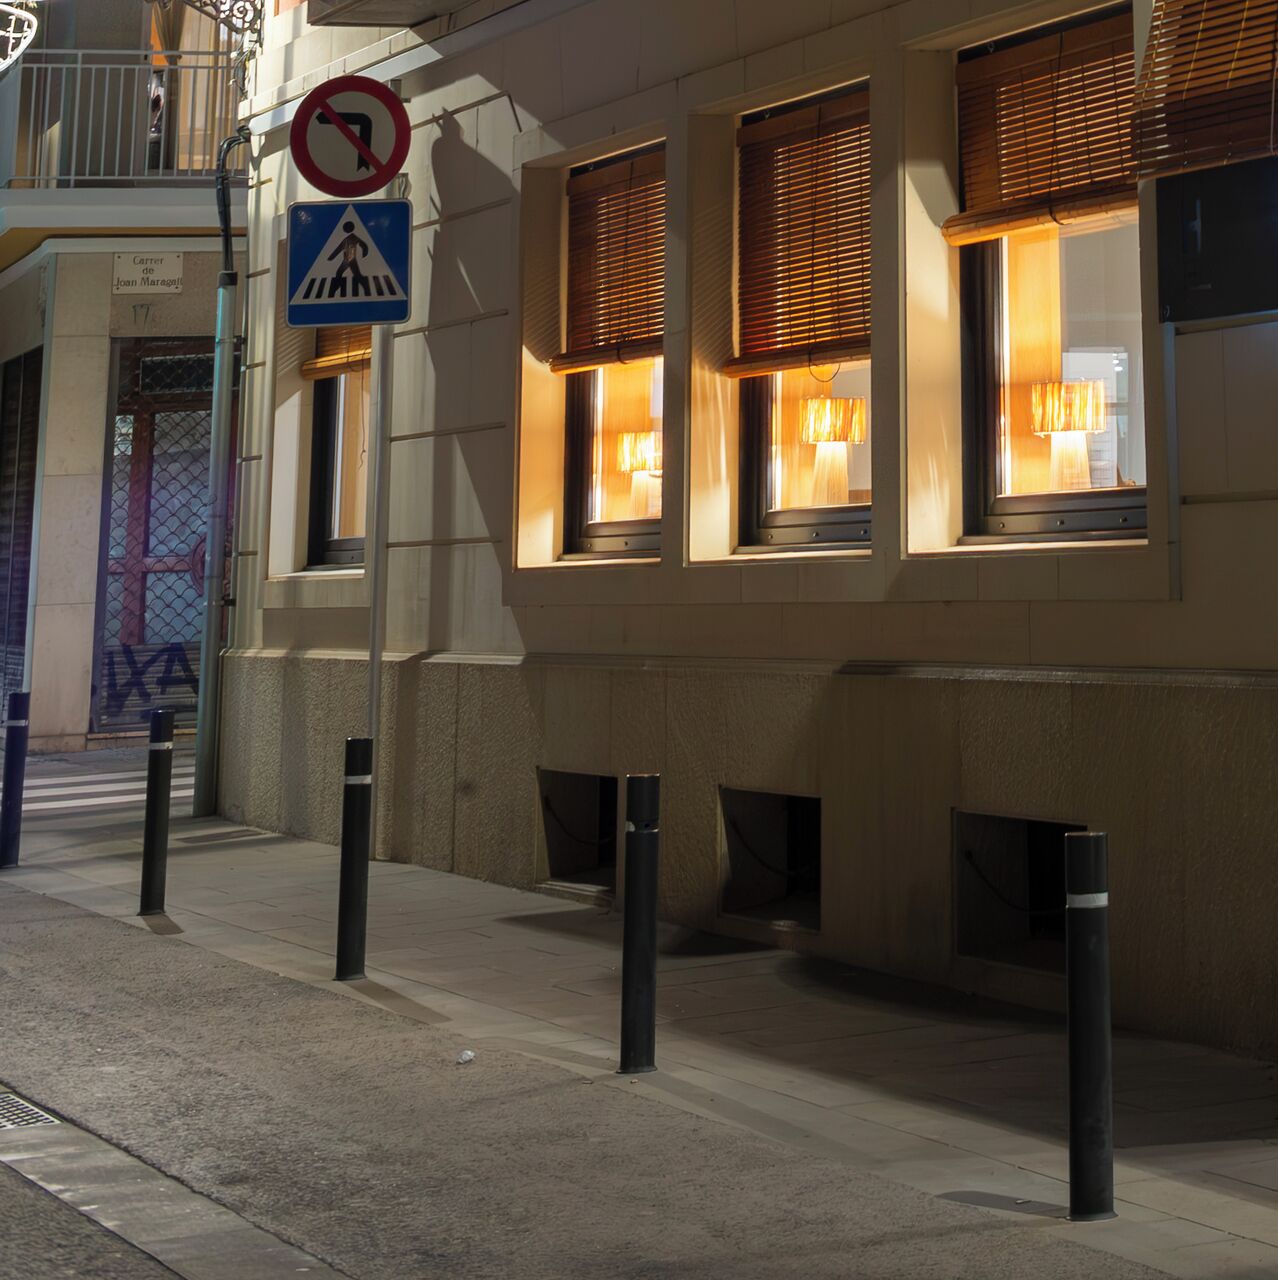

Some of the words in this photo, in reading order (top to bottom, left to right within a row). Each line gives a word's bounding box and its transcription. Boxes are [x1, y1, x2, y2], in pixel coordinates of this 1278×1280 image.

[132, 255, 164, 265] Carrer
[142, 267, 155, 275] de
[114, 277, 138, 287] Joan
[140, 276, 183, 288] Maragall
